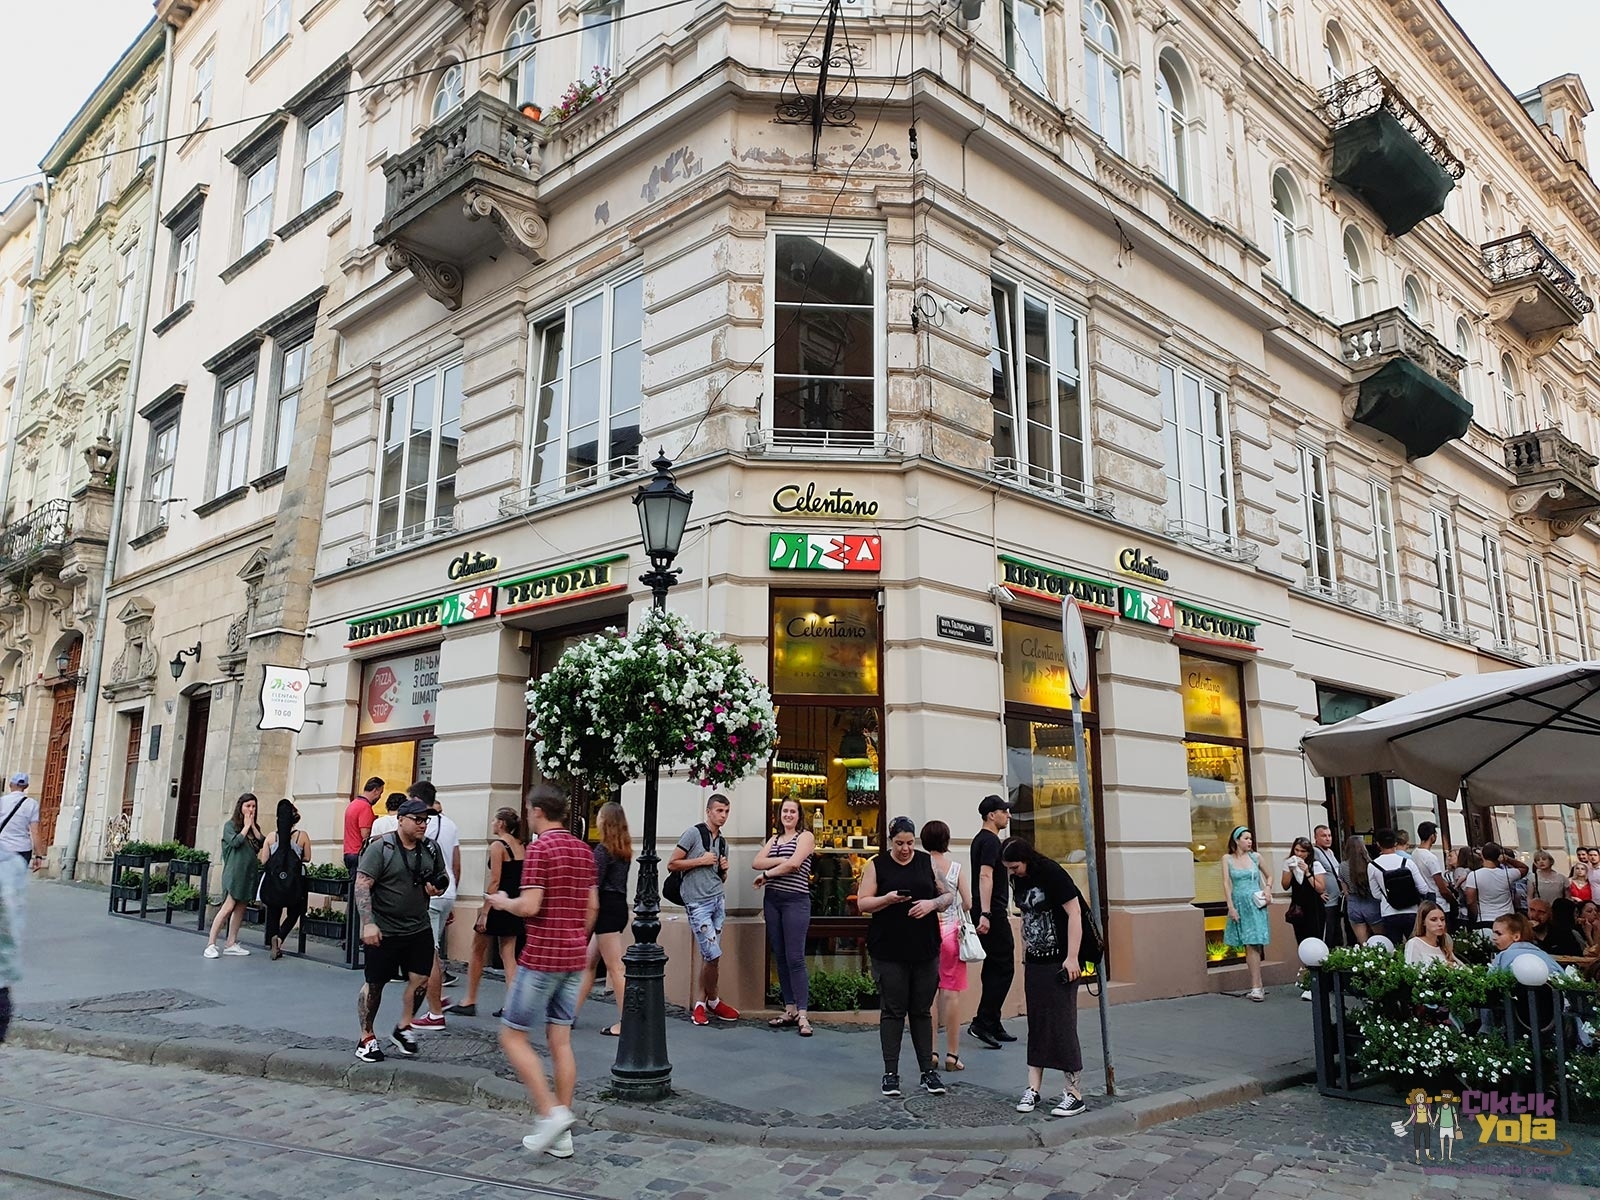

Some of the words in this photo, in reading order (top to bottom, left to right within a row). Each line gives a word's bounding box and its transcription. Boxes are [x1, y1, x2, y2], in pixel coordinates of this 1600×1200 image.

[772, 481, 879, 516] Celentano
[447, 551, 498, 580] Celentano
[1119, 548, 1170, 582] Celentano
[507, 564, 610, 606] РЕСТОРАН
[1003, 562, 1116, 608] RISTORANTE
[348, 605, 439, 641] RISTORANTE
[786, 616, 866, 638] Celentano
[1181, 609, 1257, 642] РЕСТОРАН
[374, 671, 392, 687] PIZZA
[372, 703, 389, 717] STOP
